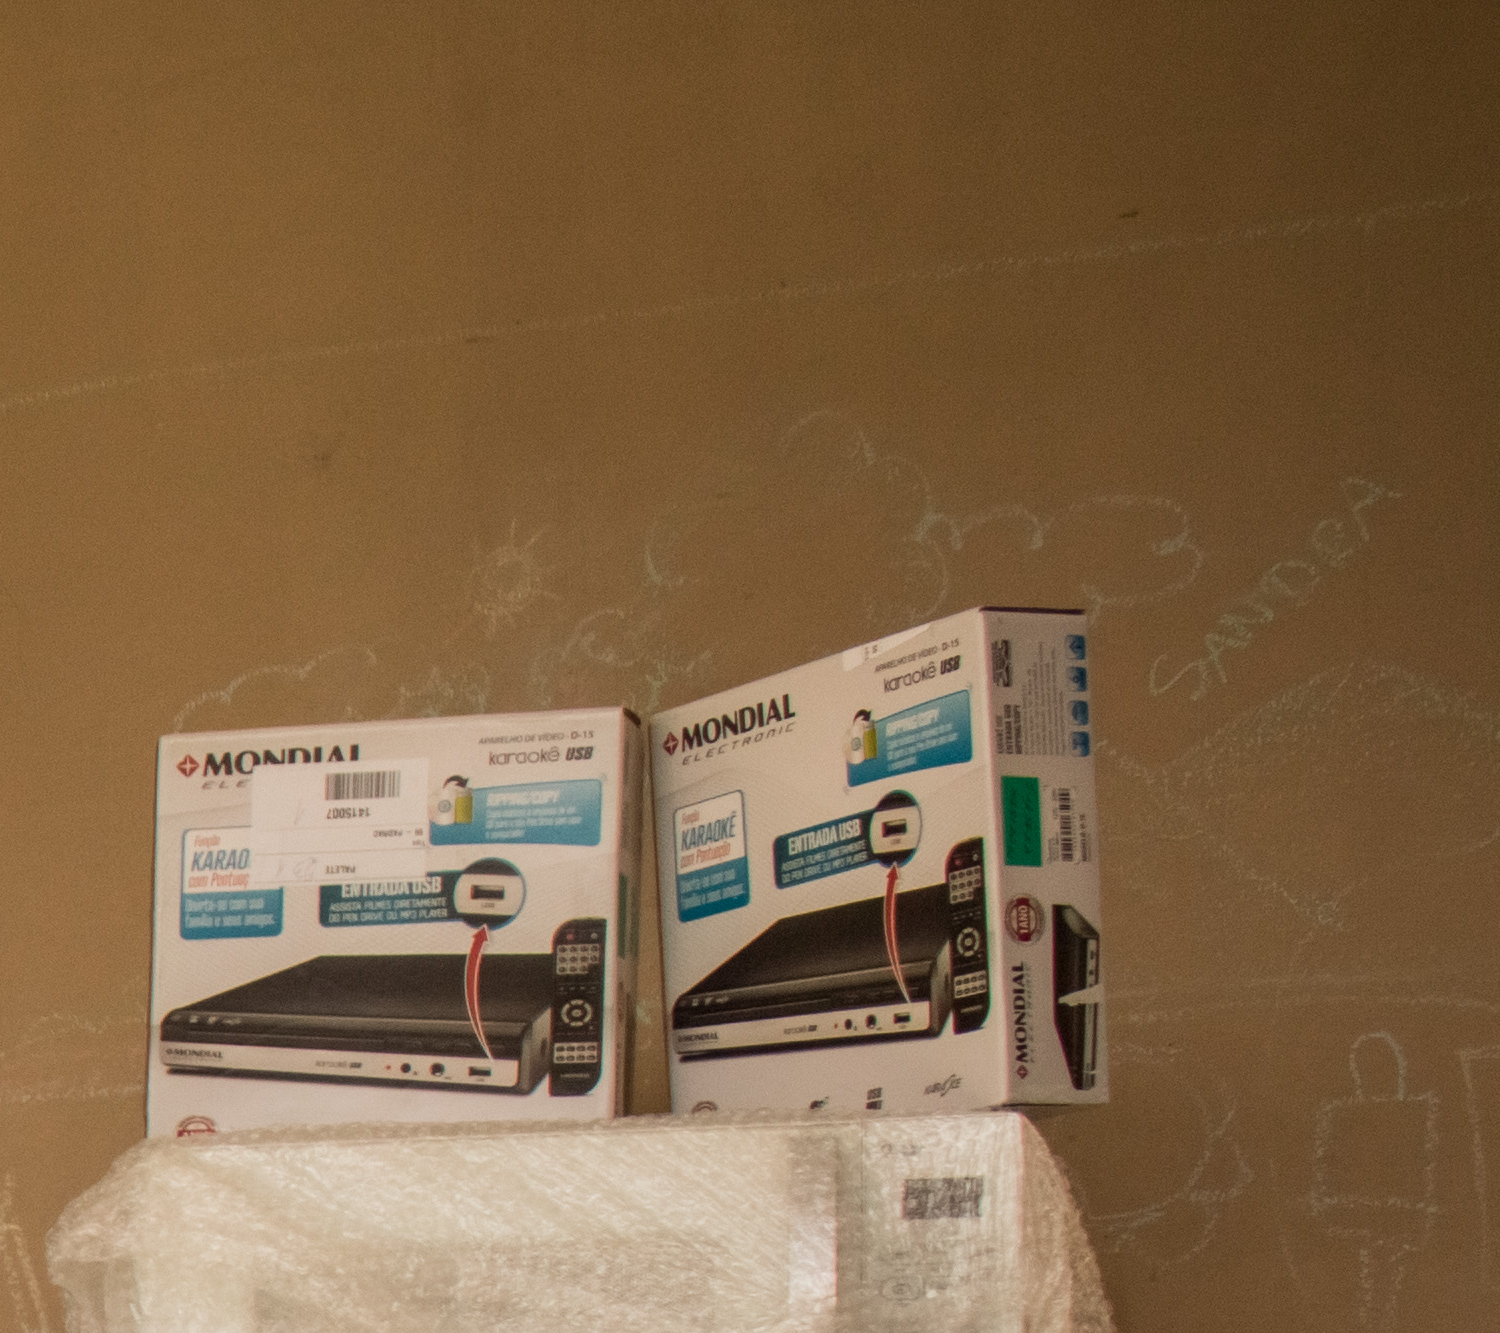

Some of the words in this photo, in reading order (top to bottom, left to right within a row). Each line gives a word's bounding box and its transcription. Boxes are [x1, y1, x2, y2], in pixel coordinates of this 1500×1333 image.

[940, 655, 961, 676] USB
[682, 693, 796, 753] MONDIAL
[565, 746, 594, 762] USB
[682, 721, 796, 766] ELECTRONIC
[787, 825, 838, 856] ENTRADA
[838, 818, 862, 841] USB
[190, 847, 251, 872] KARAO
[412, 876, 443, 894] USB
[1013, 961, 1029, 1063] MONDIAL
